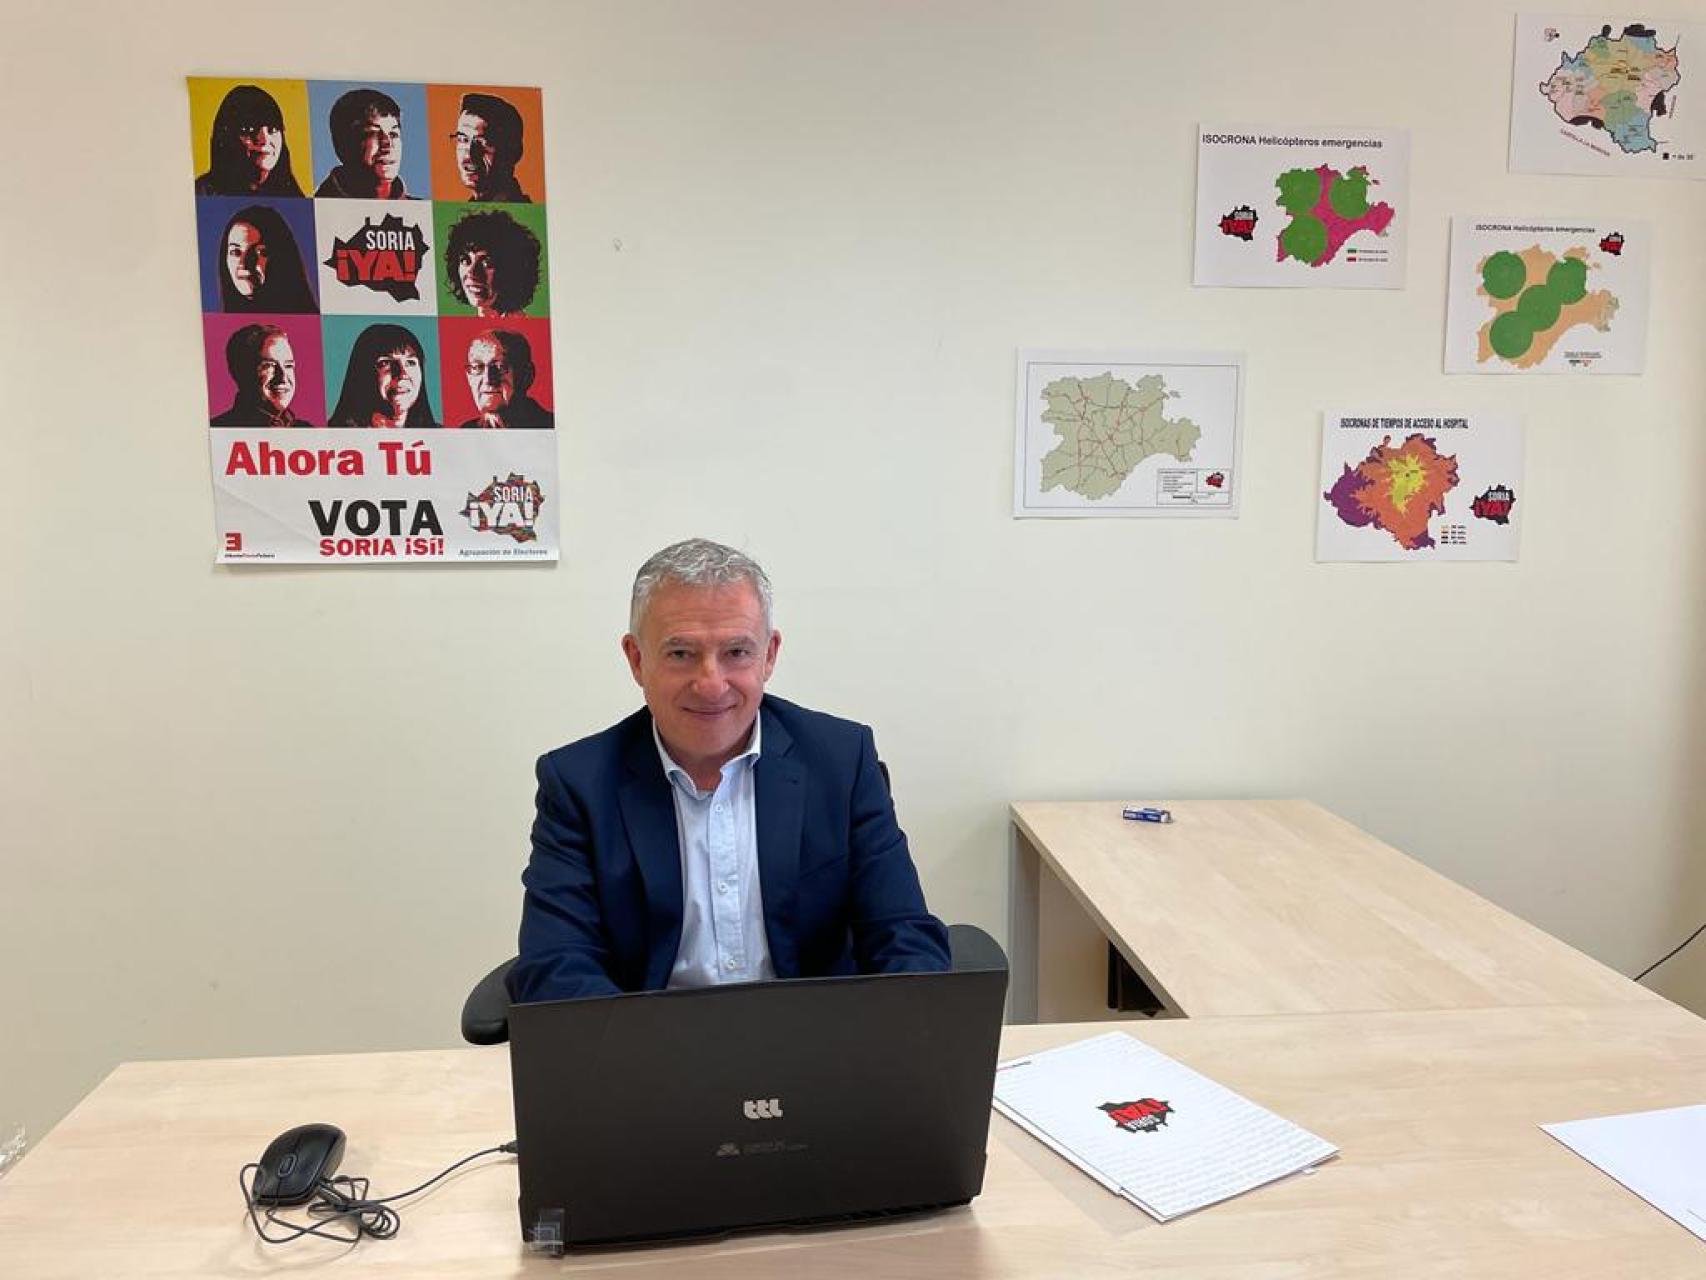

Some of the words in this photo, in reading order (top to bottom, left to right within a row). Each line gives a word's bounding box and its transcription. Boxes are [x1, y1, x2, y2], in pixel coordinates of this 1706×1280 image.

[1203, 134, 1256, 145] ISOCRONA
[1321, 139, 1383, 149] emergencias
[366, 229, 415, 251] SORIA
[336, 250, 416, 282] ¡YA!
[226, 441, 364, 476] Ahora
[379, 440, 432, 476] Tú
[494, 486, 533, 502] SORIA
[308, 499, 444, 536] VOTA
[319, 538, 397, 556] SORIA
